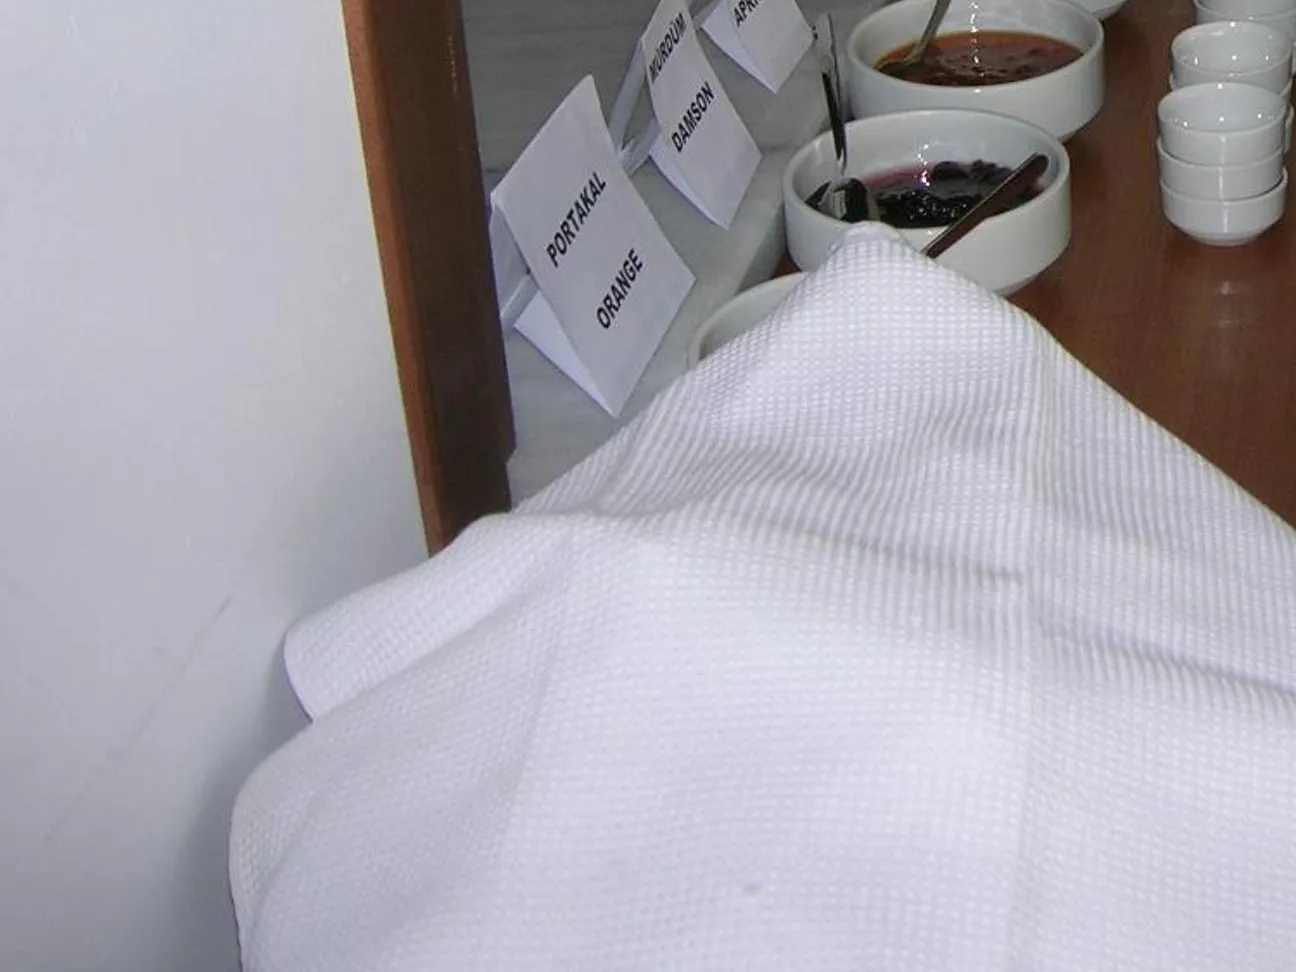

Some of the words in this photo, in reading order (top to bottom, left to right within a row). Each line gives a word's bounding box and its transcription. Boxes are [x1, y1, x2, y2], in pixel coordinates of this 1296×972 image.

[671, 80, 715, 153] DAMSON
[546, 172, 607, 268] PORTAKAL
[596, 248, 644, 331] ORANGE
